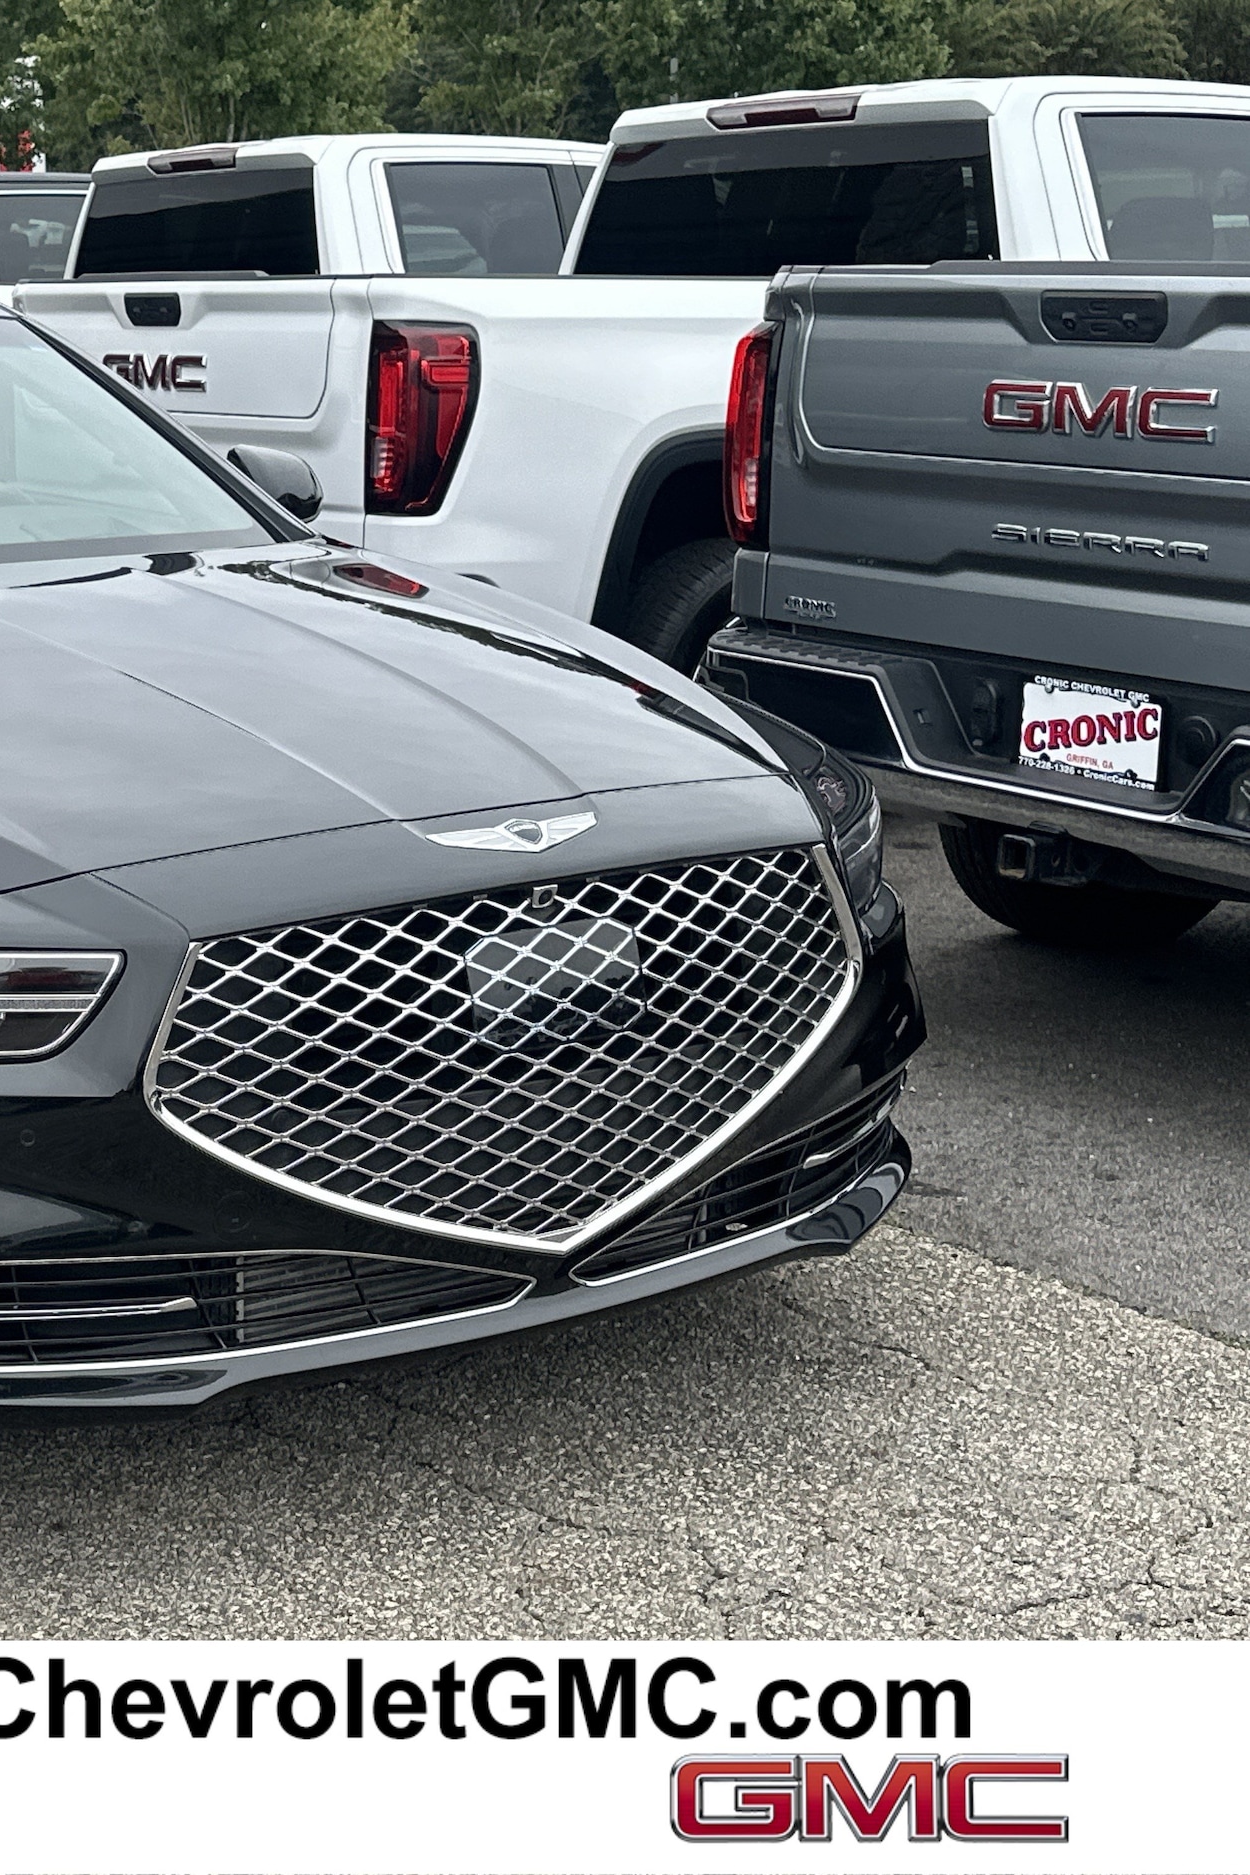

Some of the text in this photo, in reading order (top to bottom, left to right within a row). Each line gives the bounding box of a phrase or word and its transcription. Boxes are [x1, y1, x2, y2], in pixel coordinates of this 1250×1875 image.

[102, 353, 207, 392] GMC
[983, 379, 1219, 443] GMC
[991, 523, 1209, 561] SIERRA
[1034, 675, 1150, 702] CRONIC CHEVROLET GMC
[1023, 708, 1159, 752] CRONIC
[1066, 753, 1114, 770] GRIFFIN, GA
[1083, 769, 1155, 791] CronicCars.com
